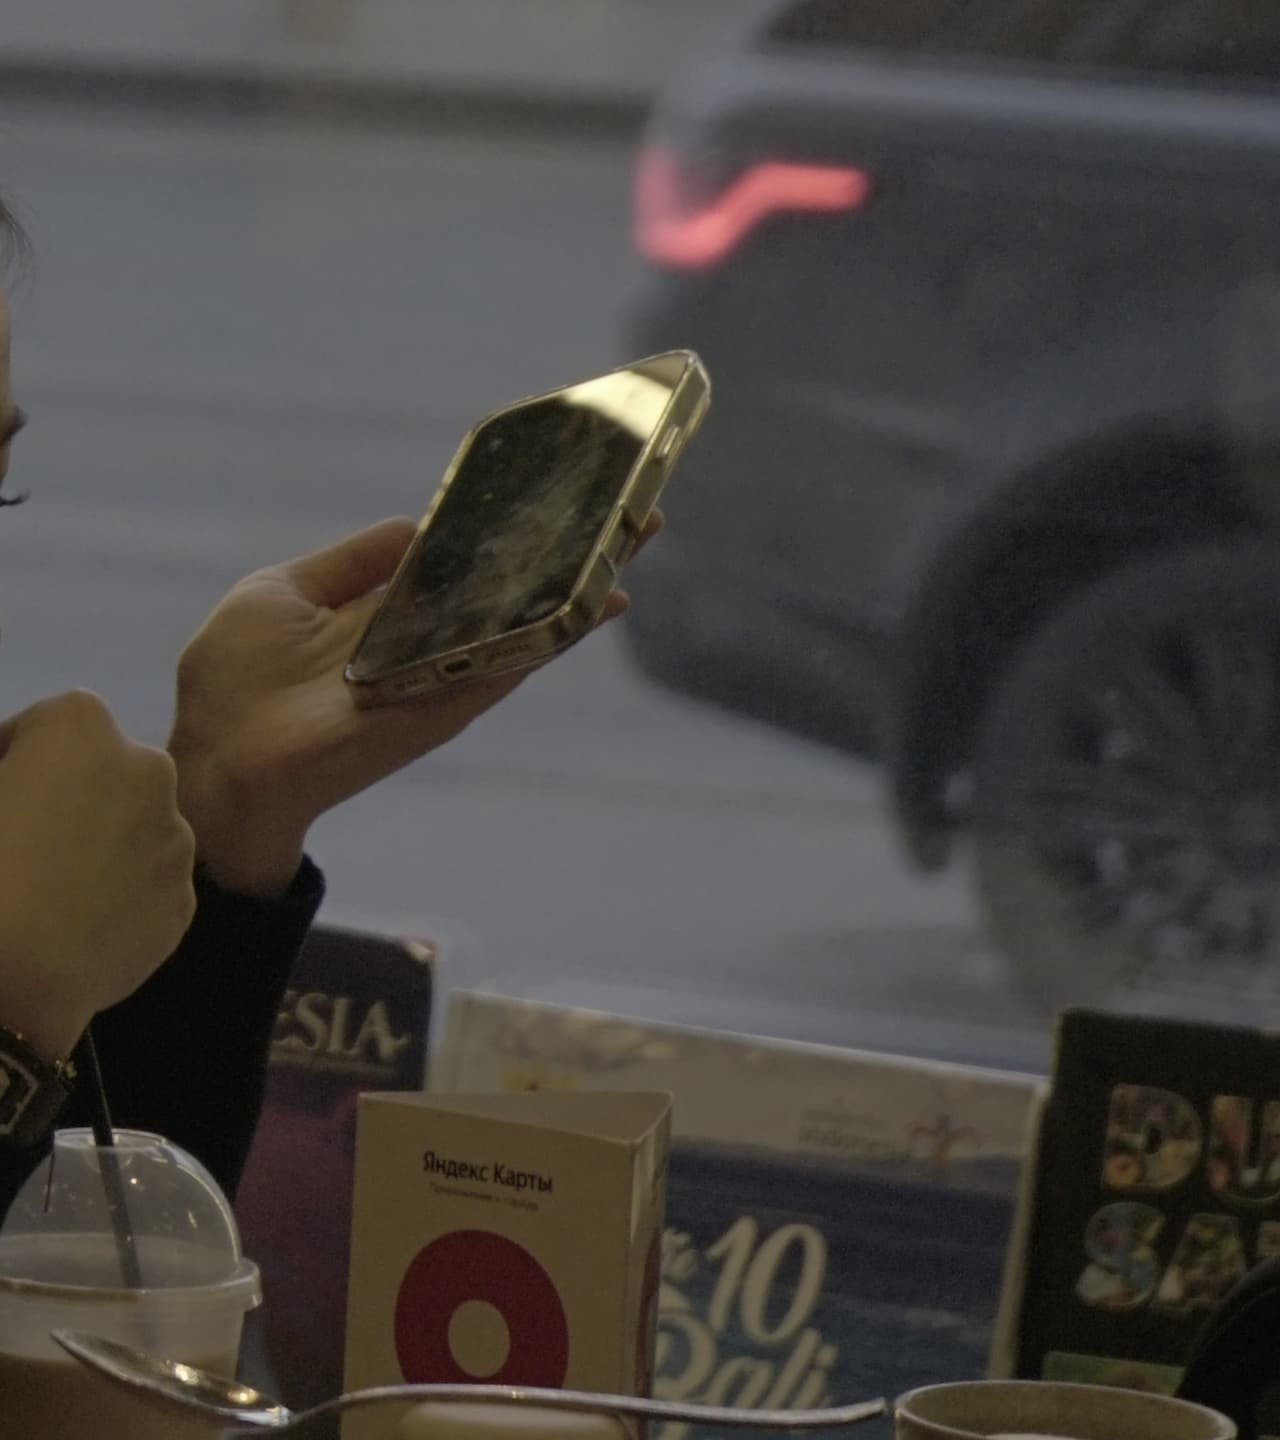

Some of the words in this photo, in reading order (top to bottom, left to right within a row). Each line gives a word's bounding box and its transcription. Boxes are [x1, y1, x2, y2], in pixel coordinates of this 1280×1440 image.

[422, 1150, 489, 1184] Яндекс
[492, 1162, 553, 1193] Карты
[704, 1214, 829, 1346] 10
